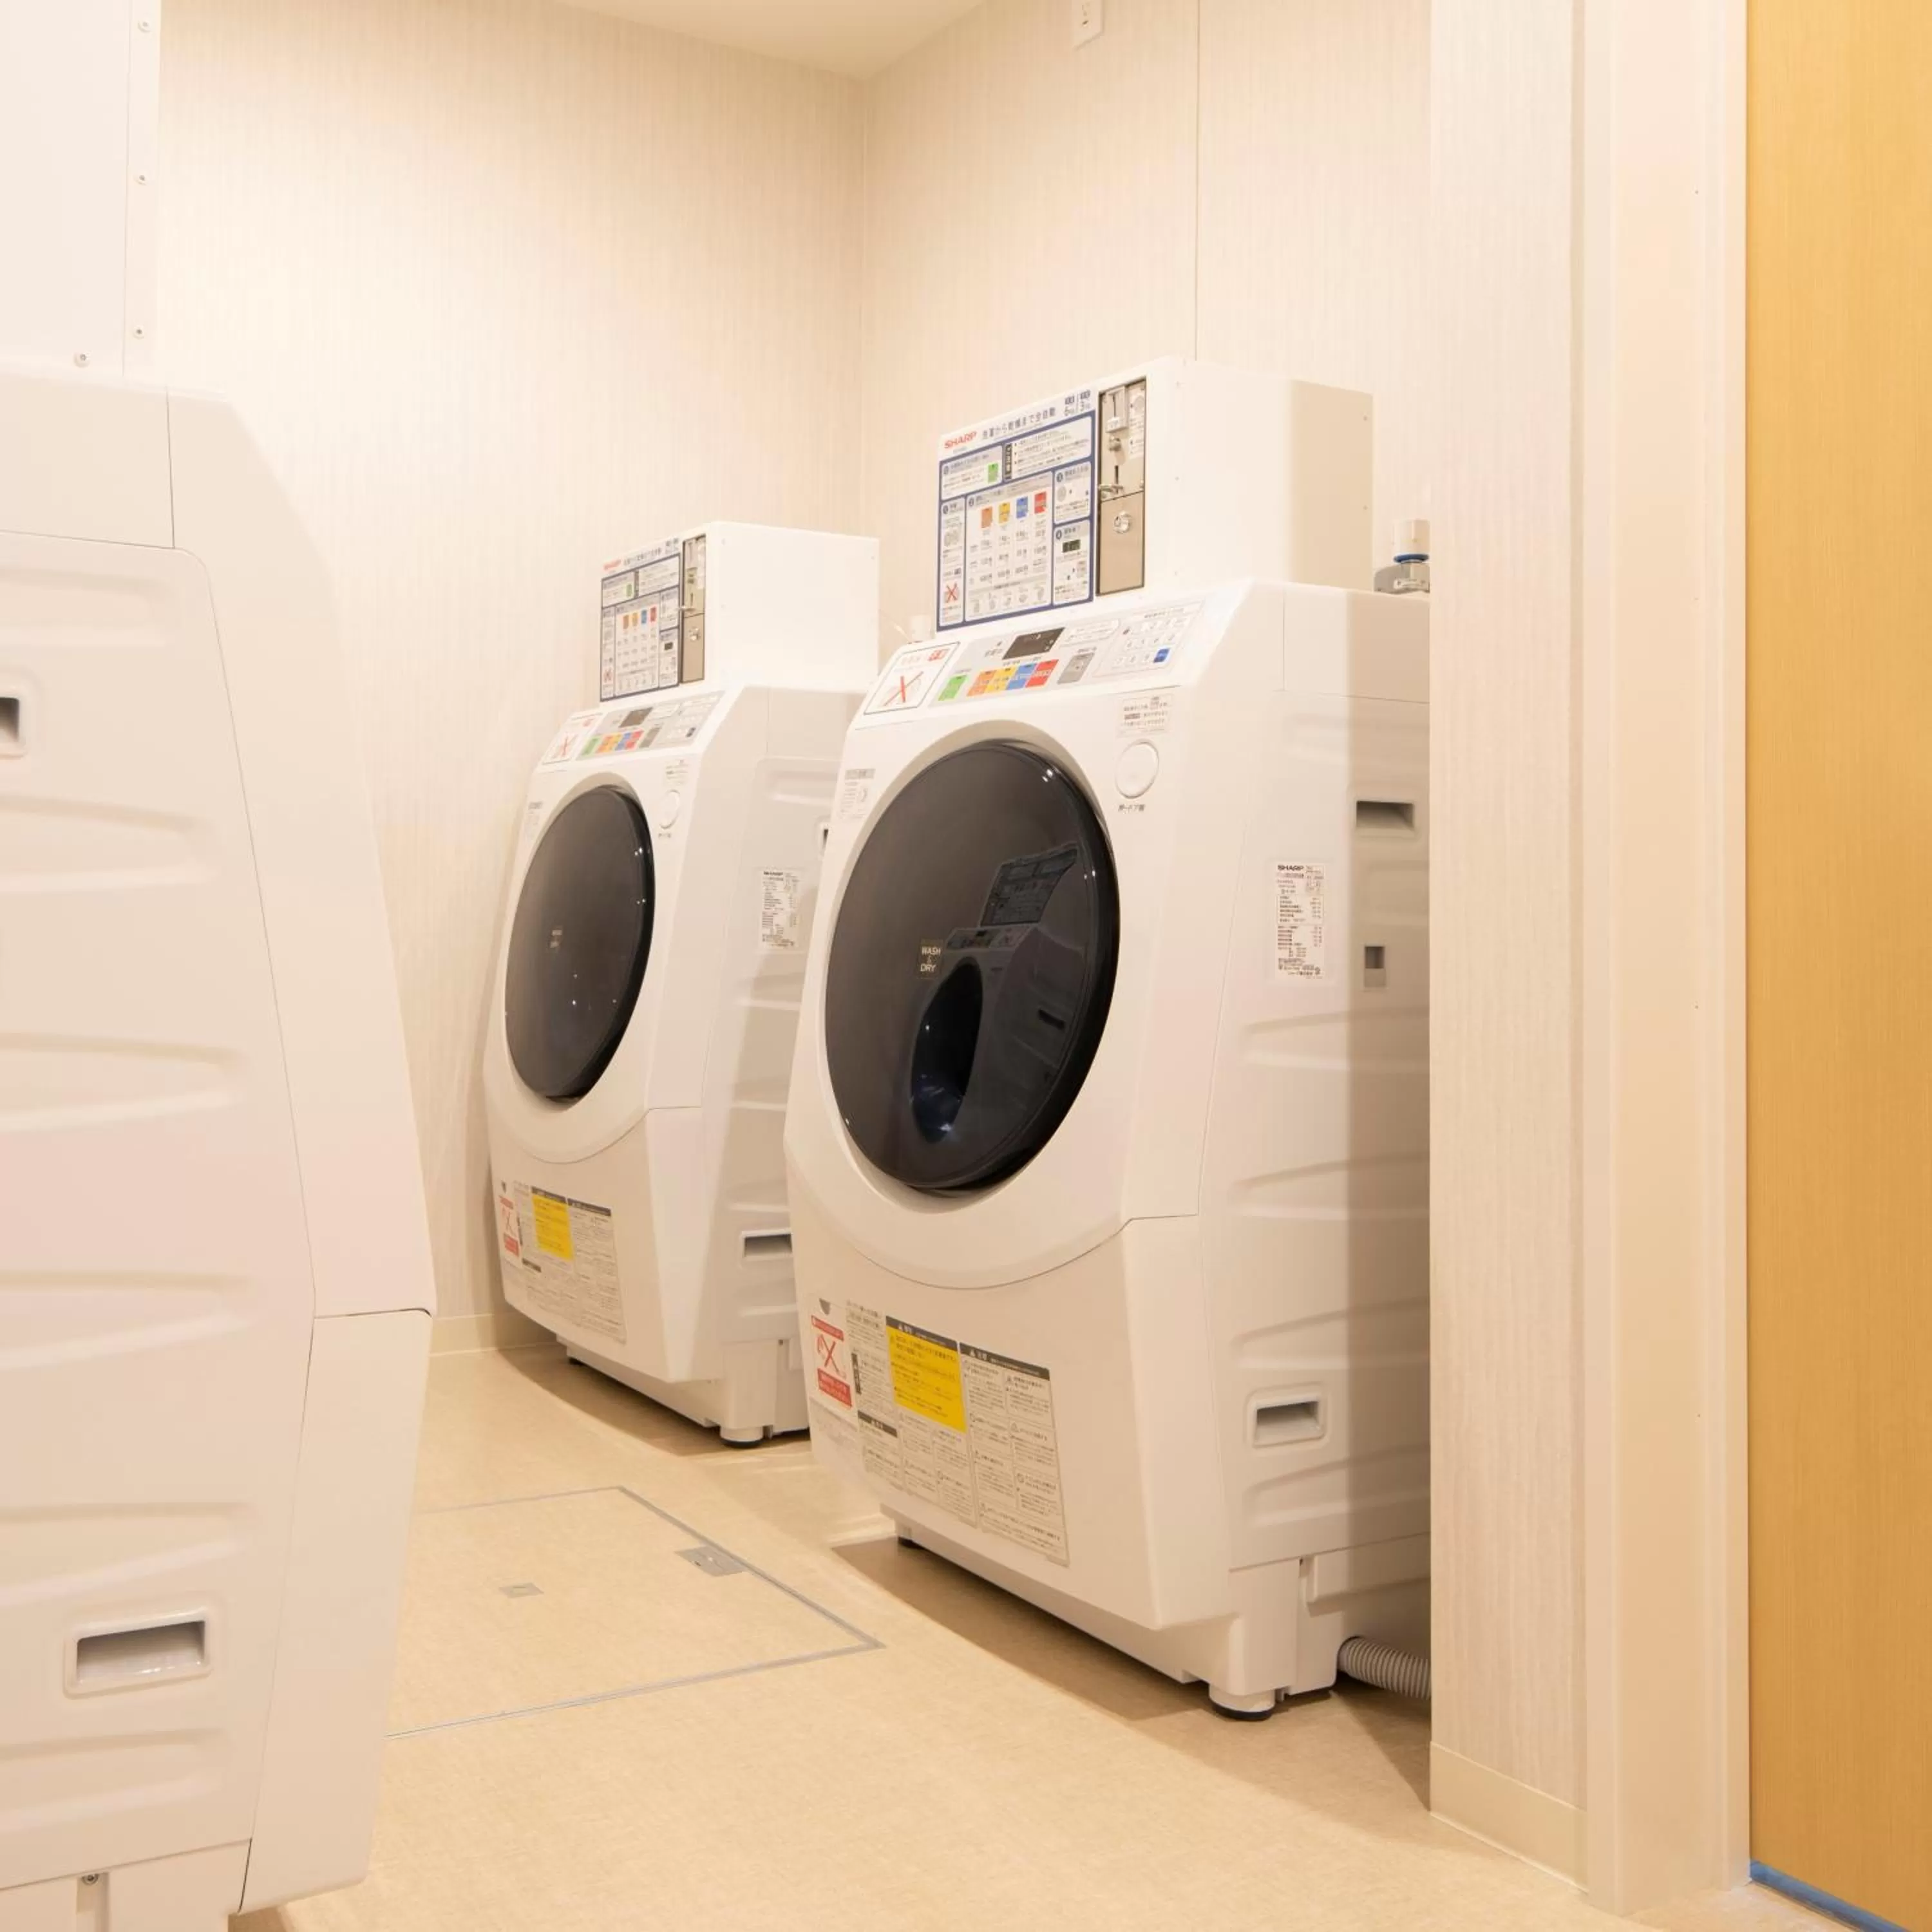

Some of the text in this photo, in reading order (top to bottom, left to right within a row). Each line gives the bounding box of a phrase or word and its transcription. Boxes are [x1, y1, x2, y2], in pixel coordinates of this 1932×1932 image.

[944, 430, 977, 449] SHARP
[922, 946, 941, 956] WASH
[920, 963, 936, 972] DRY
